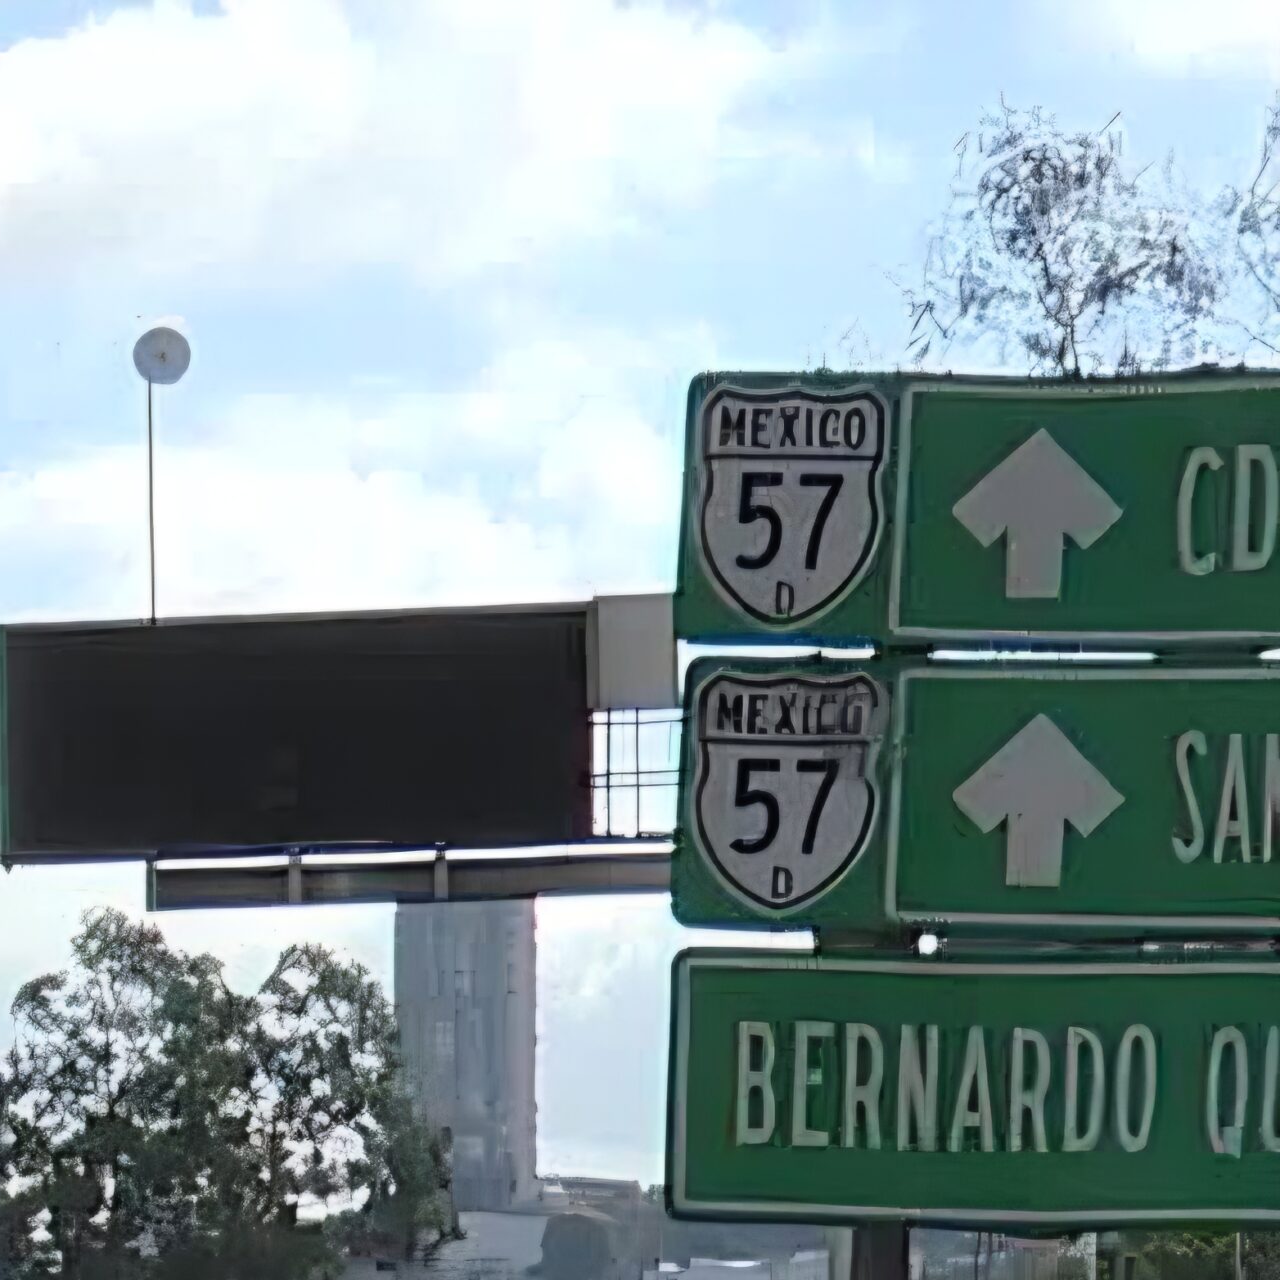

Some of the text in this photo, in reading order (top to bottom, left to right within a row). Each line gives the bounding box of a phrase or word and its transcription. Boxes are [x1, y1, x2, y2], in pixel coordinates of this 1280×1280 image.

[719, 405, 867, 450] MEXICO
[735, 471, 845, 570] 57
[775, 580, 795, 617] D
[717, 692, 863, 735] MEXICO
[729, 758, 840, 855] 57
[771, 865, 793, 899] D
[736, 1020, 1157, 1153] BERNARDO
